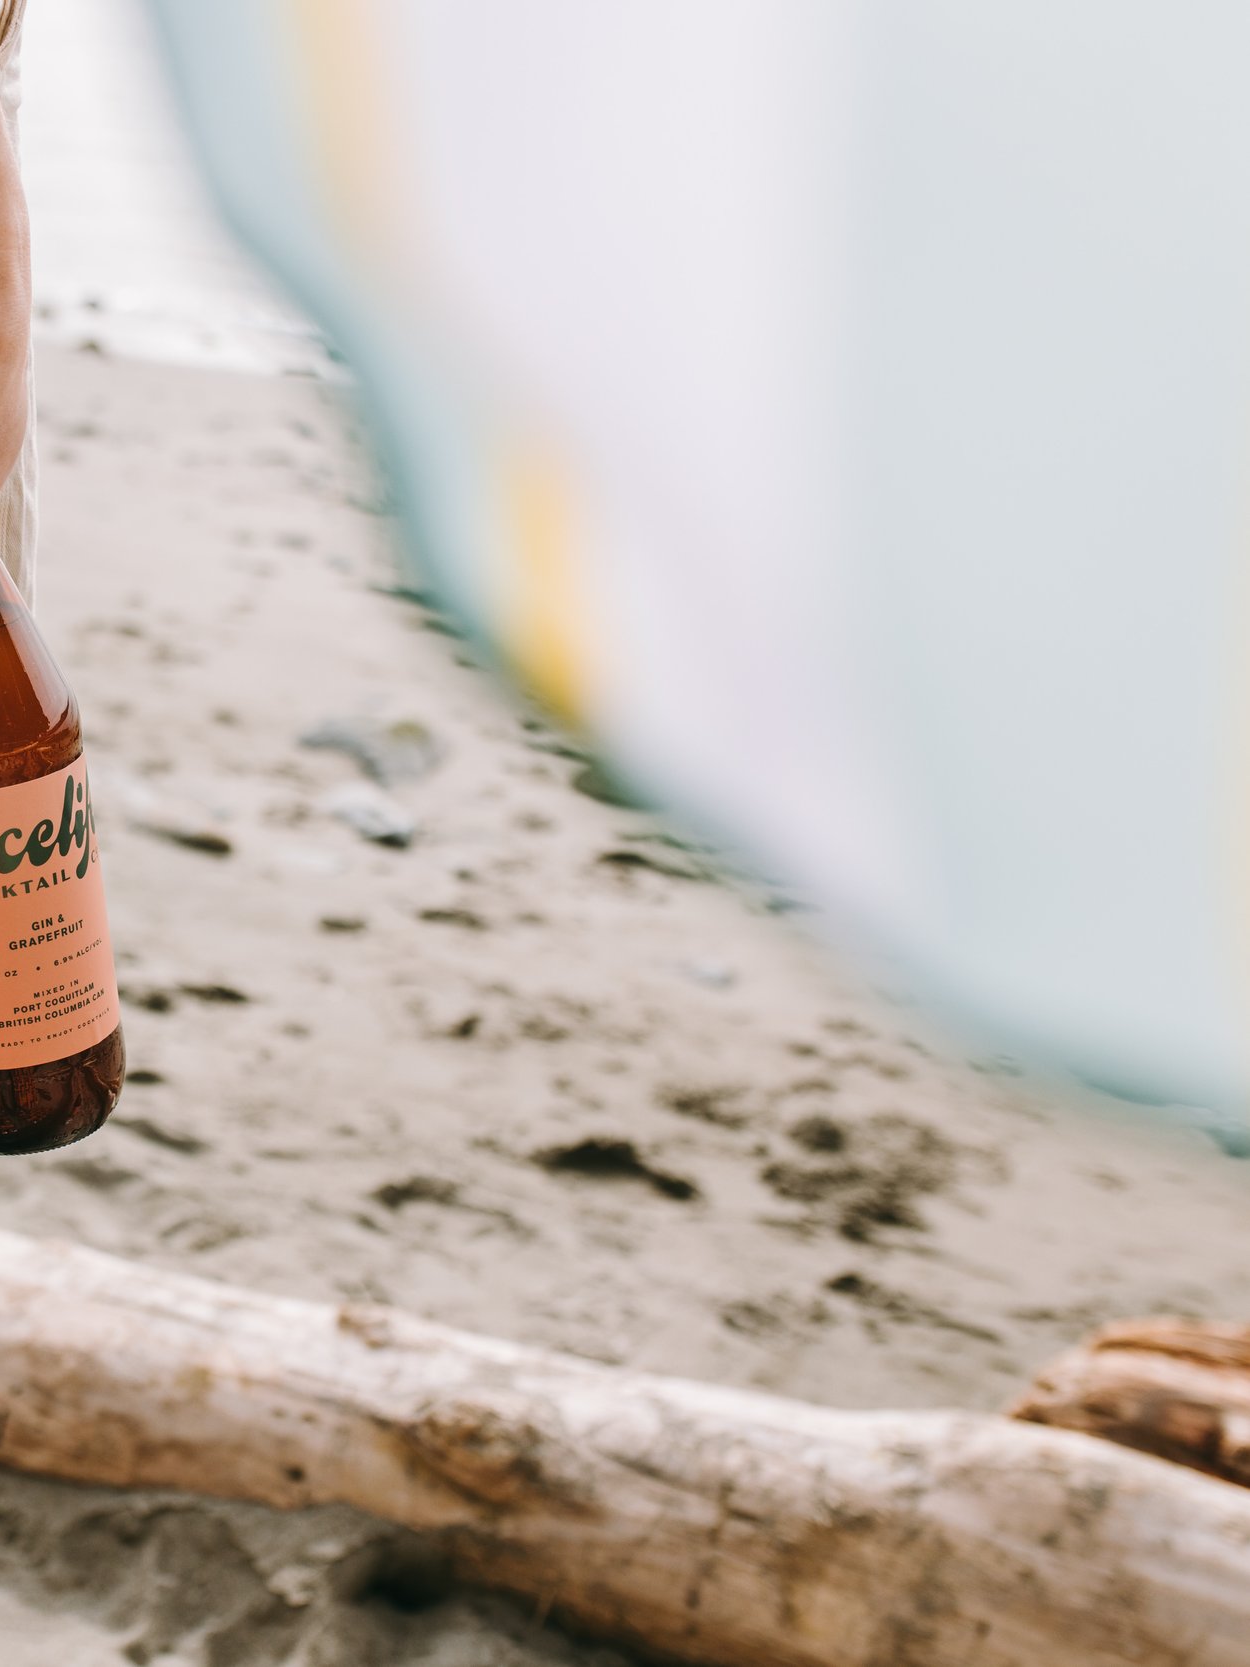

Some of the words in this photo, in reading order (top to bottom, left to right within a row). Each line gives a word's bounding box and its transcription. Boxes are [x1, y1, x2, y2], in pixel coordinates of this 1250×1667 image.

[31, 917, 53, 931] GIN
[57, 913, 65, 923] &
[8, 919, 84, 951] GRAPEFRUIT
[4, 970, 18, 978] OZ
[13, 1002, 42, 1015] PORT
[45, 982, 95, 1008] COQUITLAM
[33, 984, 65, 999] MIXED
[70, 979, 79, 988] IN
[44, 998, 91, 1020] COLUMBIA
[47, 1028, 73, 1040] ENJOY
